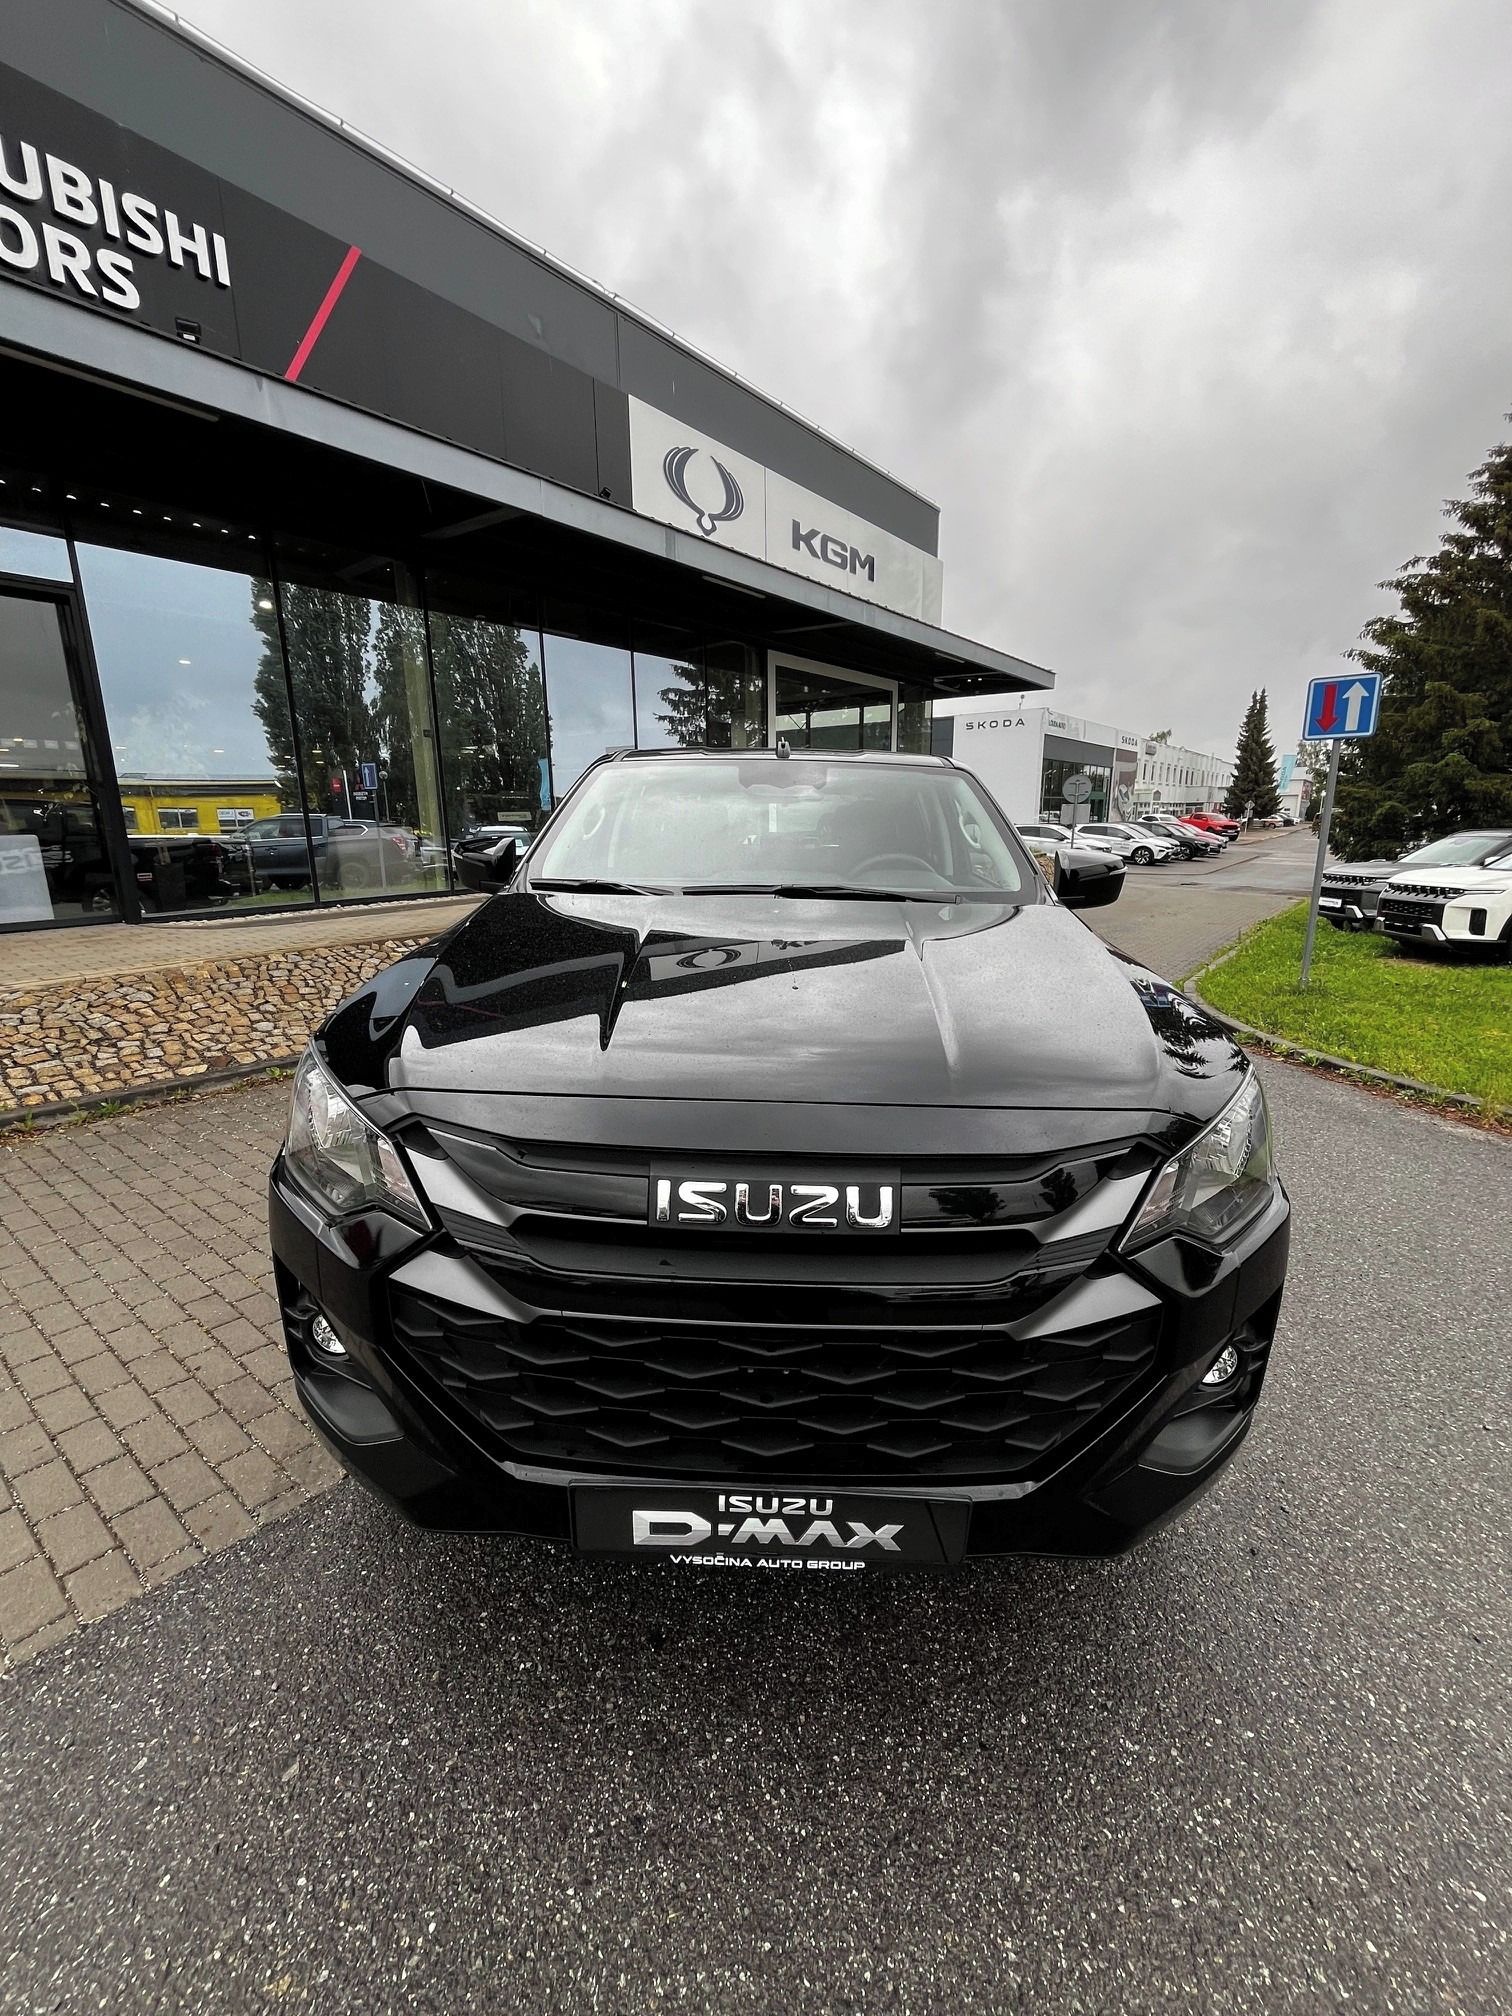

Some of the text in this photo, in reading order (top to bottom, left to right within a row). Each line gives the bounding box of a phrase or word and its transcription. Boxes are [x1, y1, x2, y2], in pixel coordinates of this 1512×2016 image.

[791, 519, 875, 582] KGM
[656, 1179, 893, 1229] ISUZU
[718, 1494, 833, 1516] ISUZU
[632, 1510, 905, 1552] D-MAX
[669, 1552, 866, 1570] VYSOČINA AUTO GROUP
